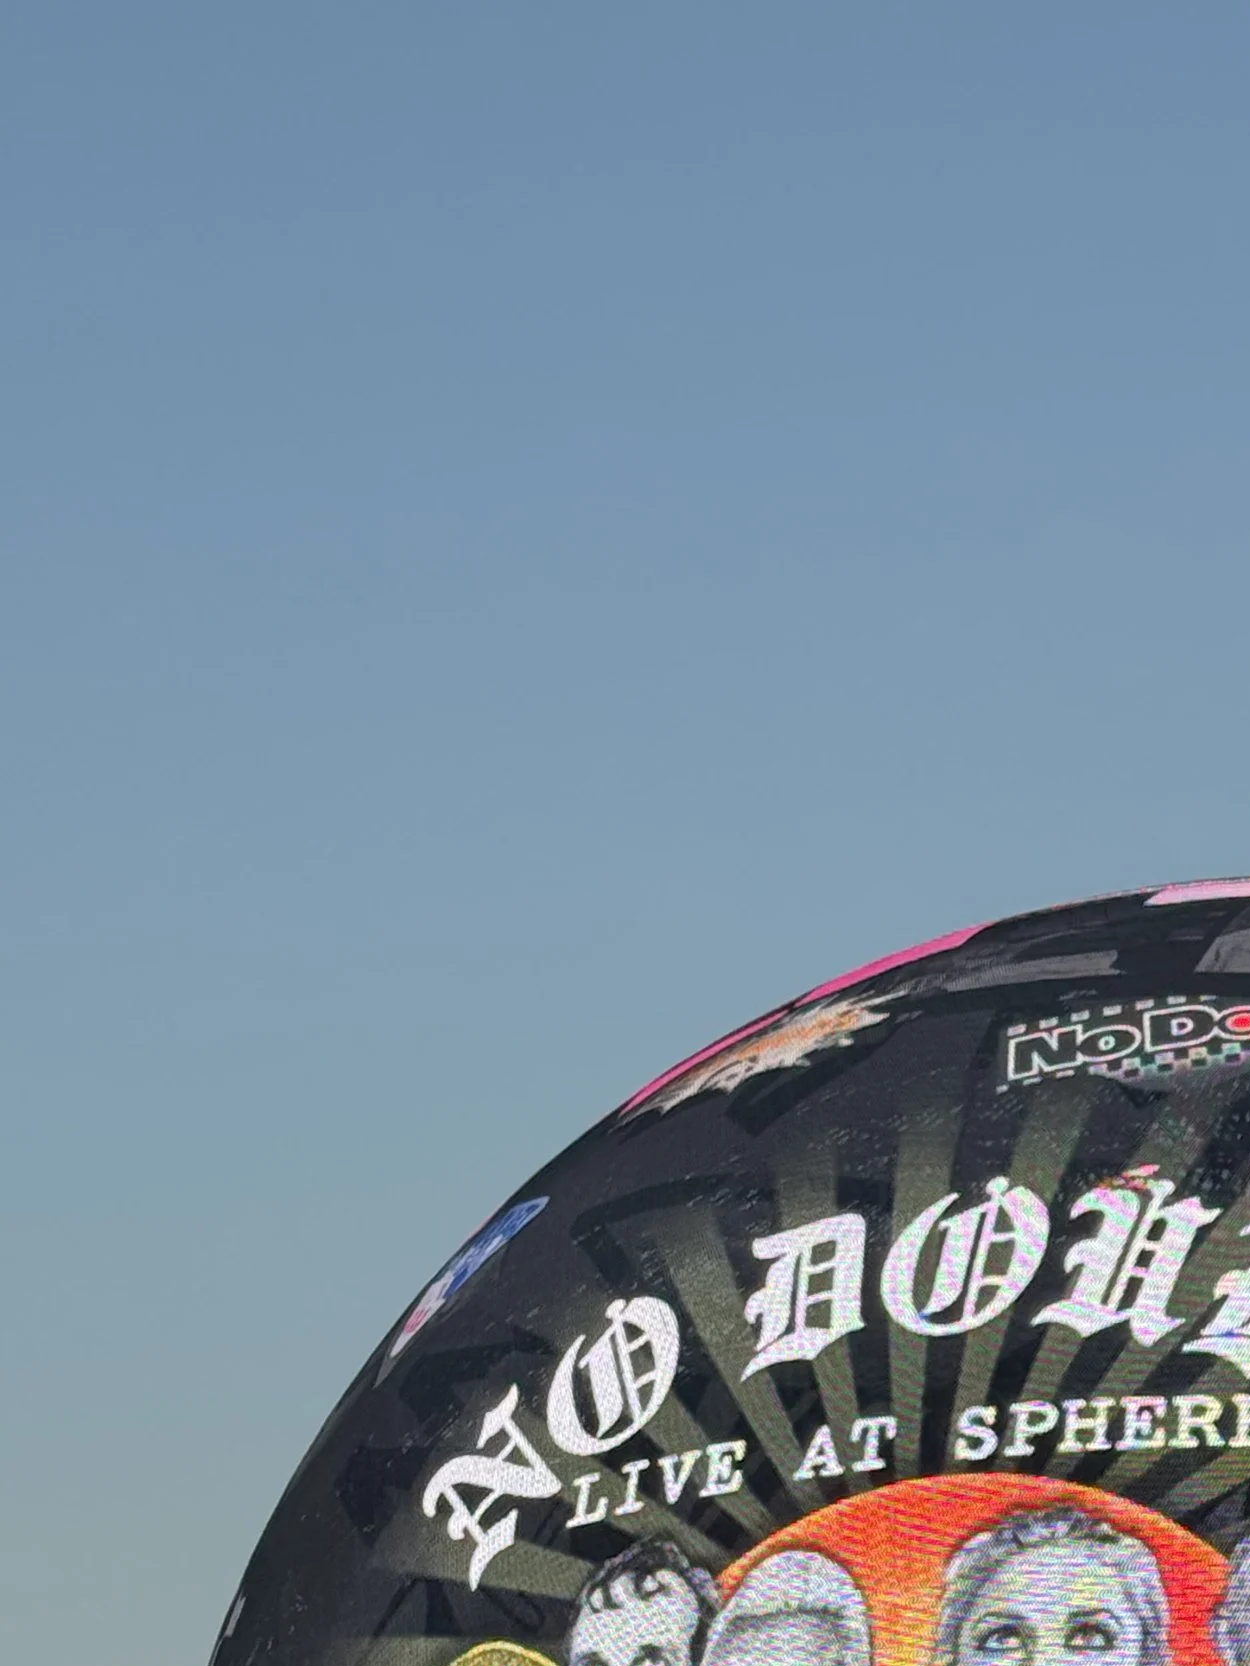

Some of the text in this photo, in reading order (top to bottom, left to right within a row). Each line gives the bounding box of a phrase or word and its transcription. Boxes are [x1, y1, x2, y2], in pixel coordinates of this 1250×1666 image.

[422, 1295, 680, 1592] NO
[566, 1439, 748, 1530] LIVE
[794, 1416, 897, 1481] AT
